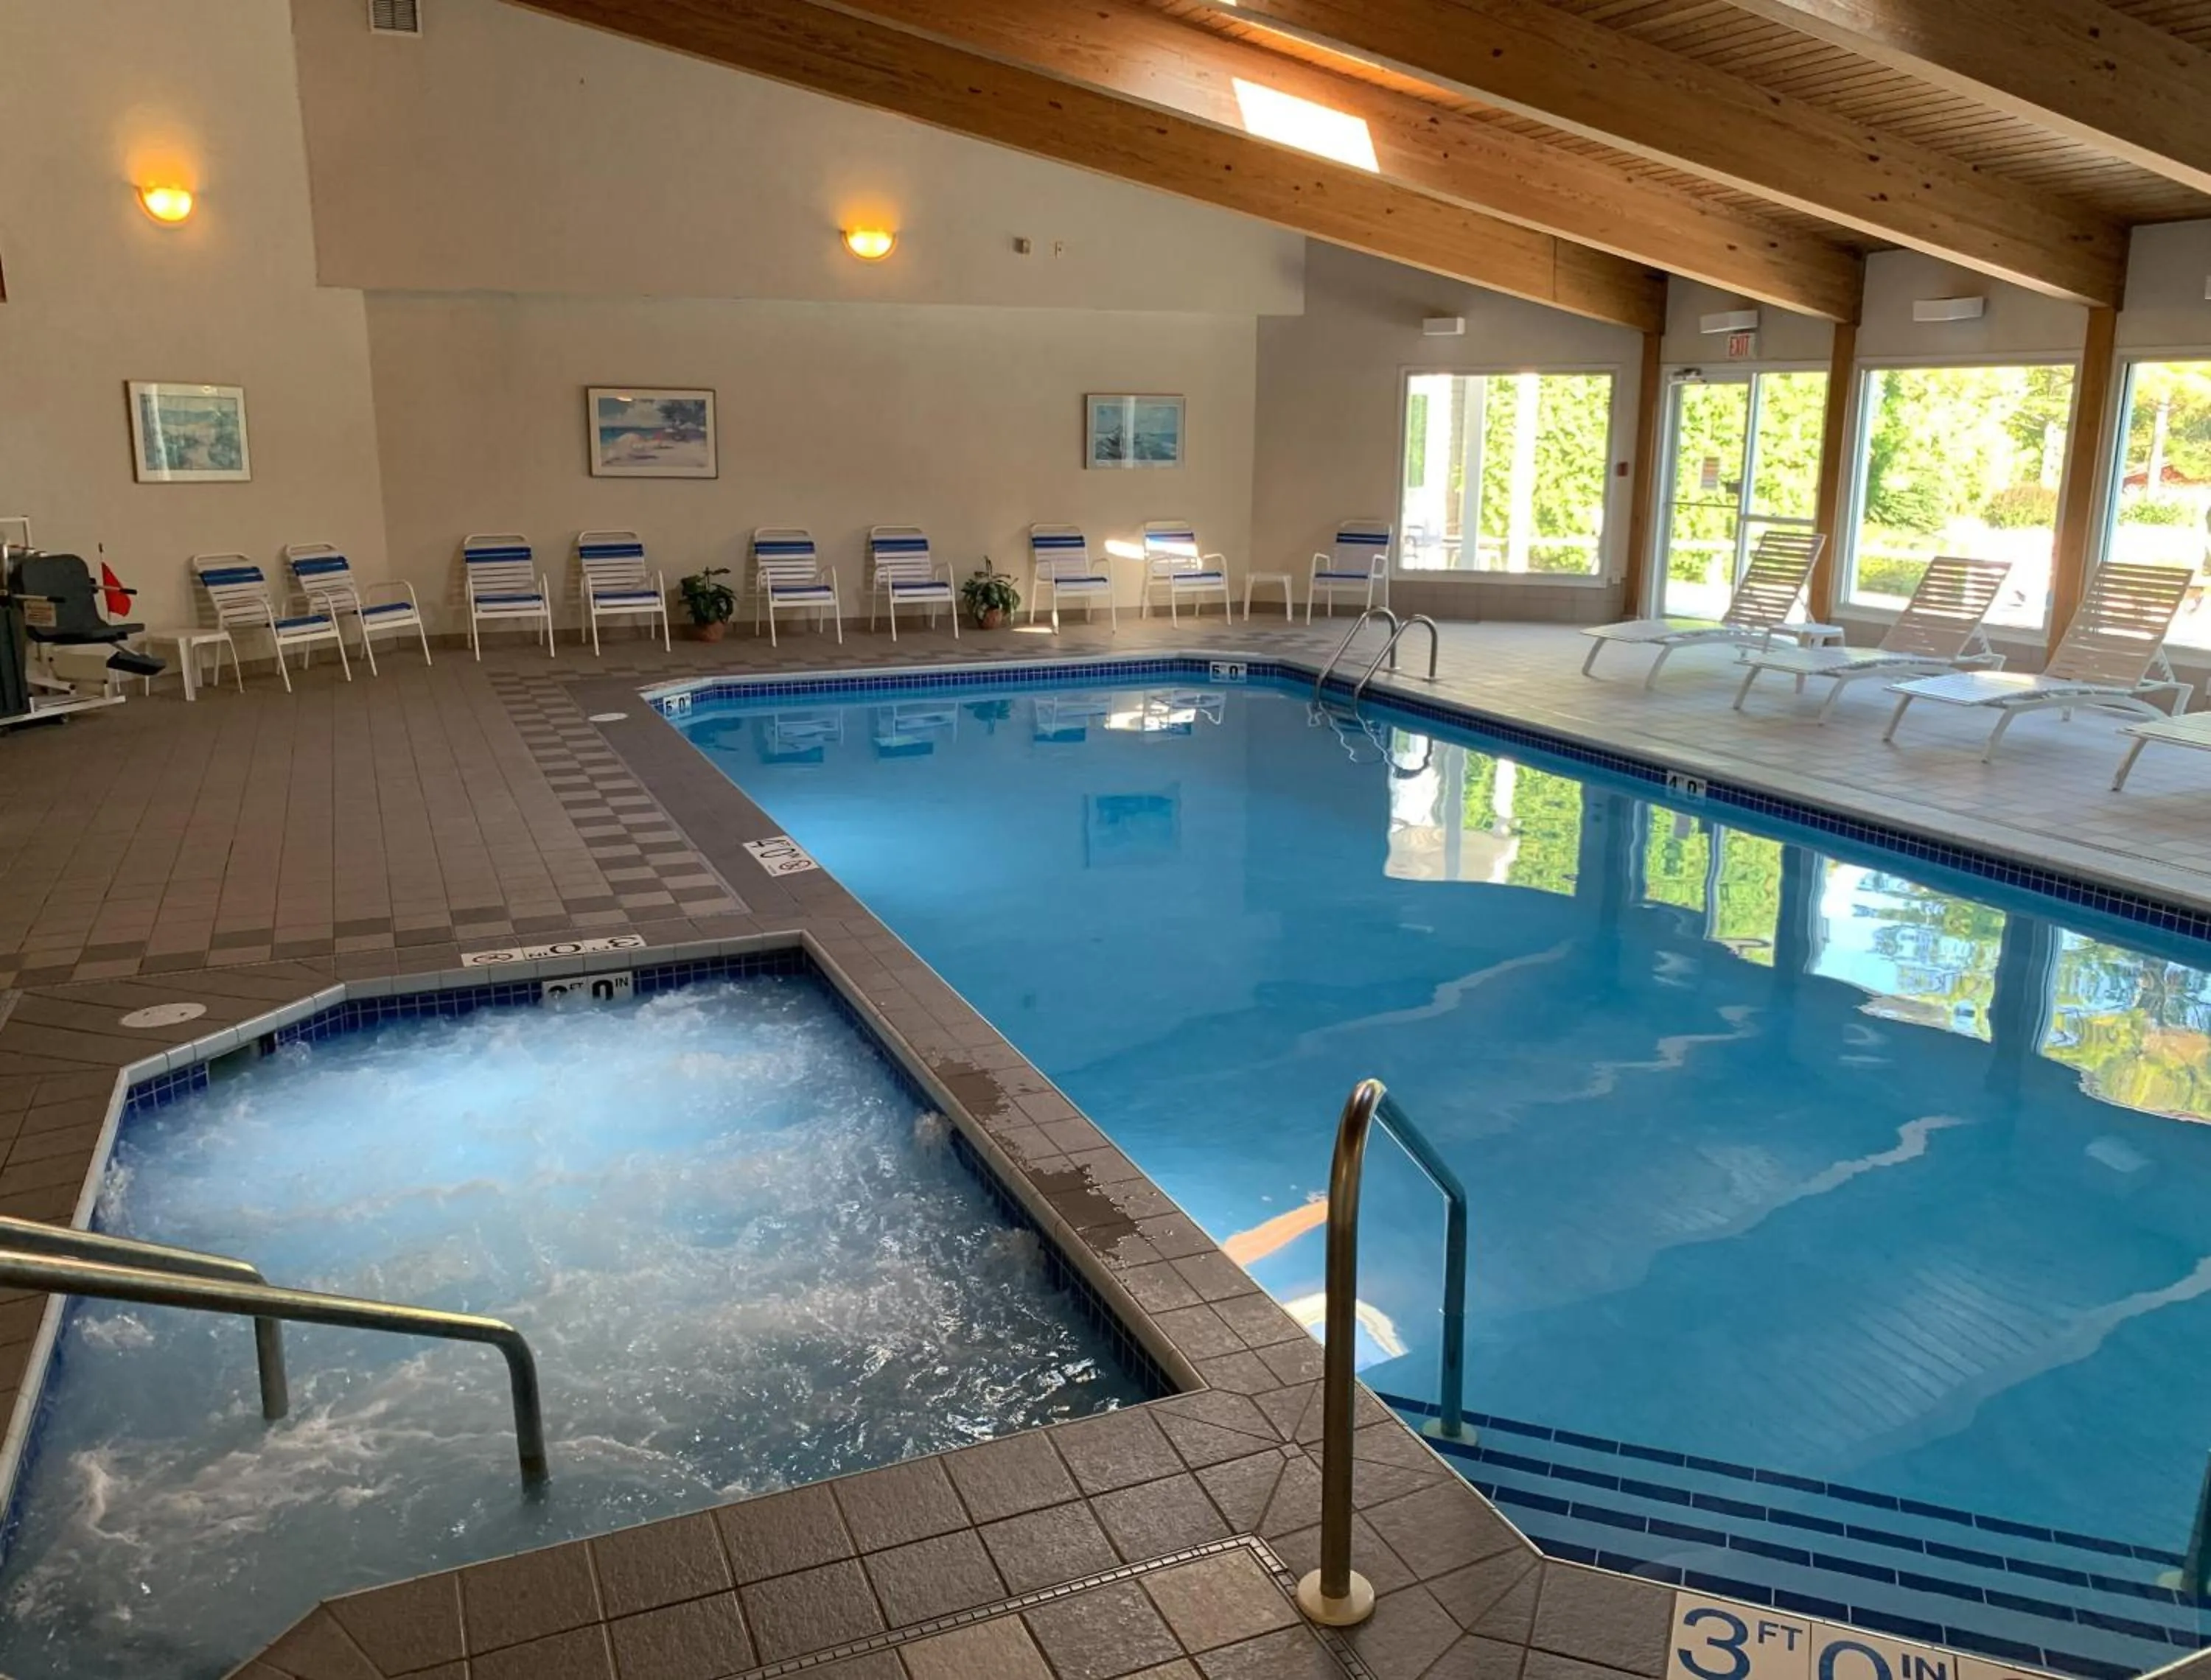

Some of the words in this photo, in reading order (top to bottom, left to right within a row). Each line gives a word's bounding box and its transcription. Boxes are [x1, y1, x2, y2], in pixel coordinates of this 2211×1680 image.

[607, 936, 640, 948] 3
[549, 944, 581, 954] 0
[615, 977, 629, 987] IN
[1677, 1608, 1750, 1680] 3
[1758, 1620, 1803, 1651] FT
[1901, 1653, 1946, 1680] IN
